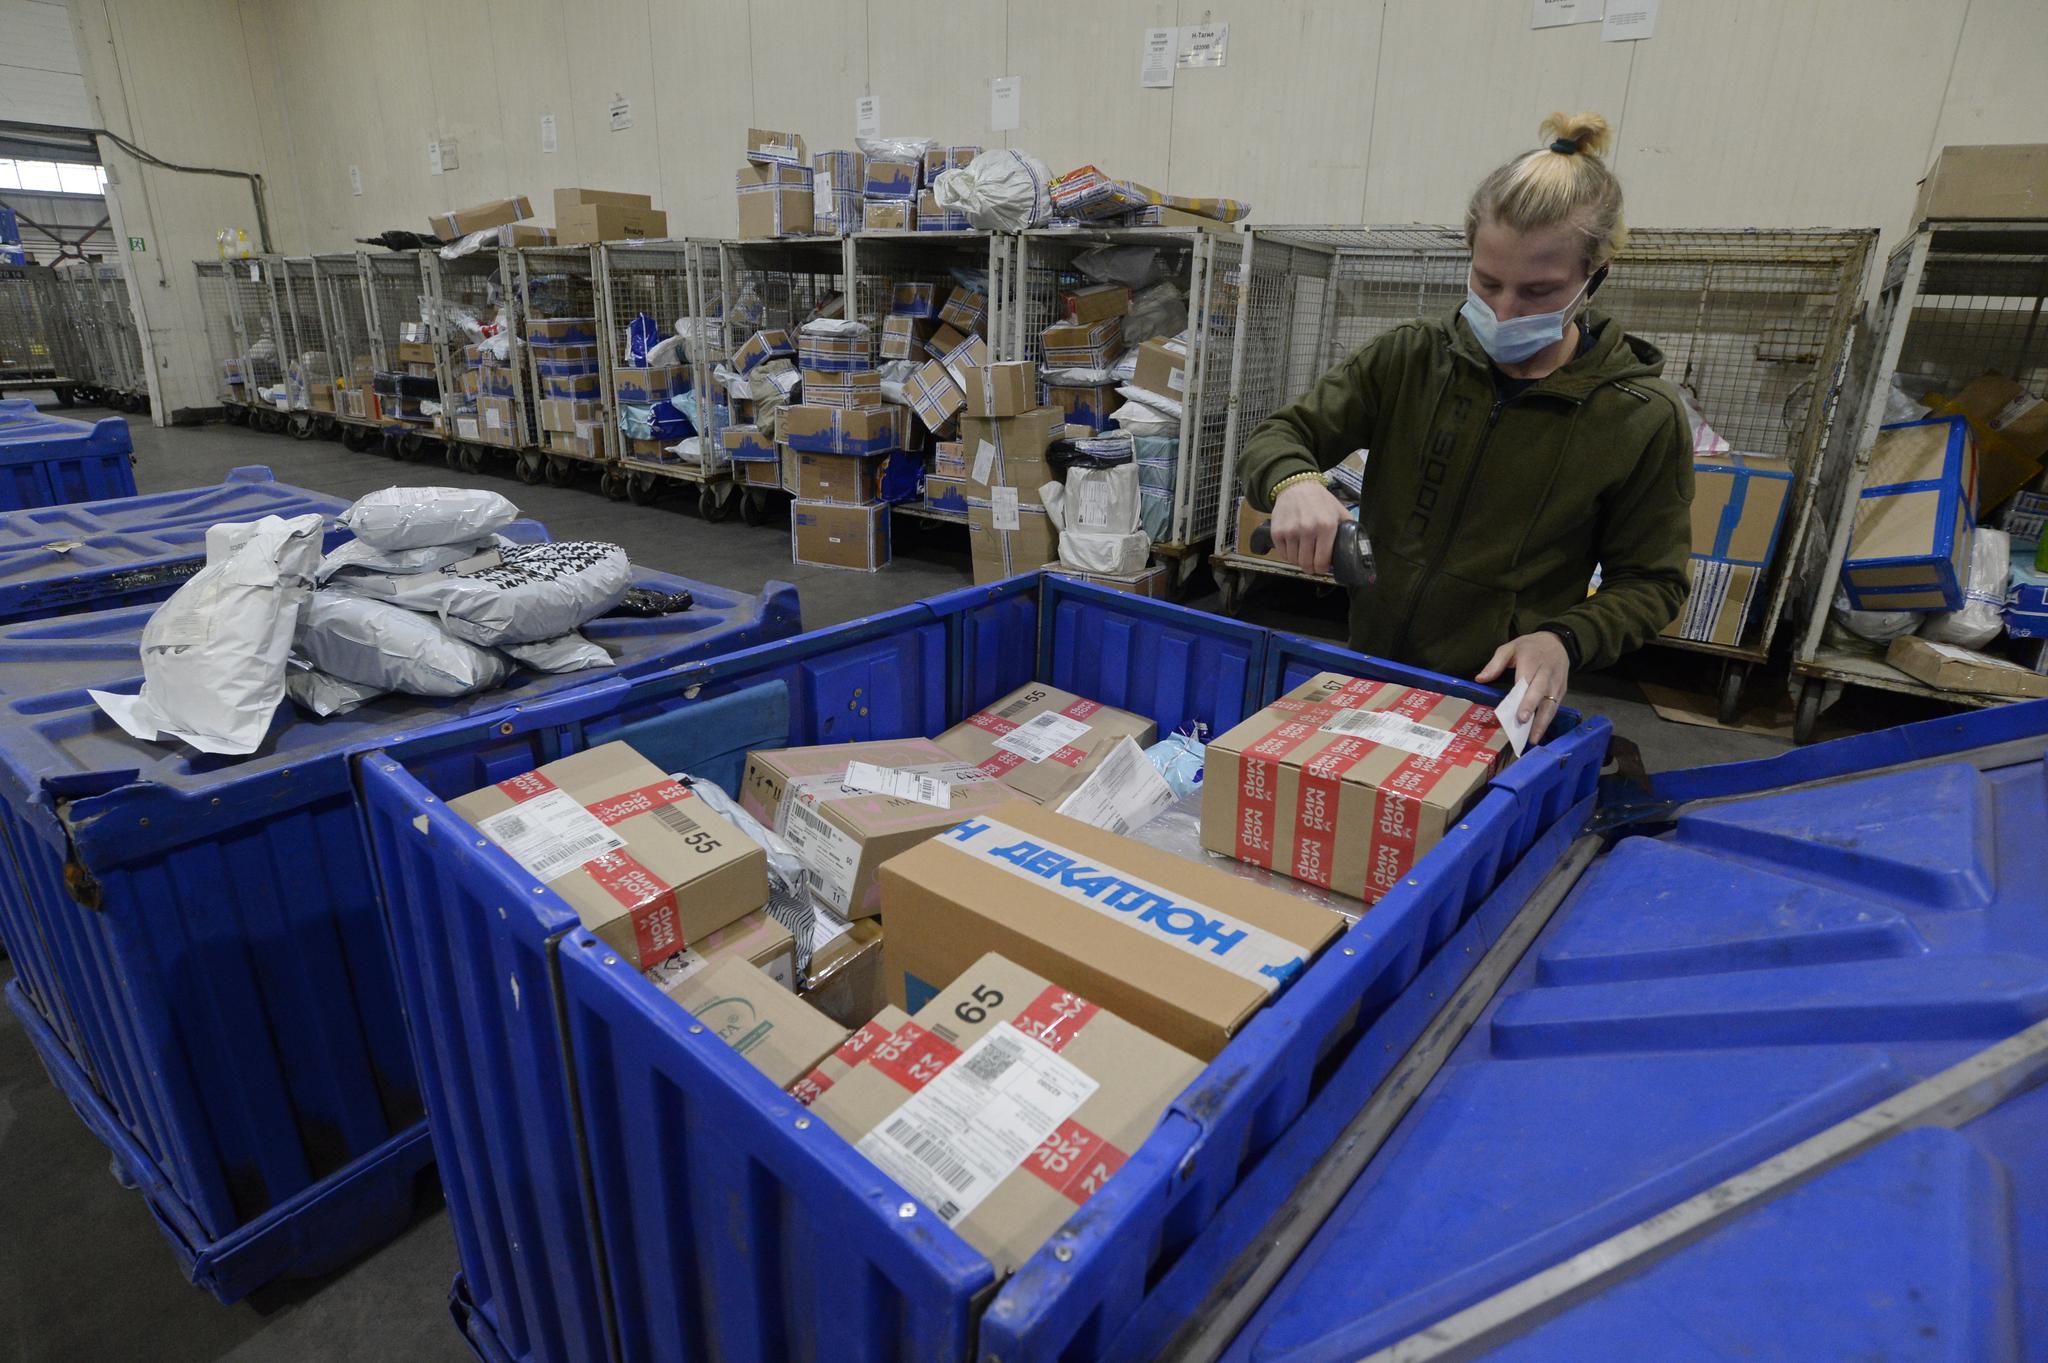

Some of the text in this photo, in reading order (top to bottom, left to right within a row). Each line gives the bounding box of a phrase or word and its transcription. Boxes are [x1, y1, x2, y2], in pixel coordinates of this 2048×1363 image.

[1024, 690, 1047, 703] 55
[1322, 680, 1345, 692] 67
[684, 831, 721, 855] 55
[987, 840, 1249, 956] ДЕКАТЛОН
[954, 984, 1005, 1025] 65
